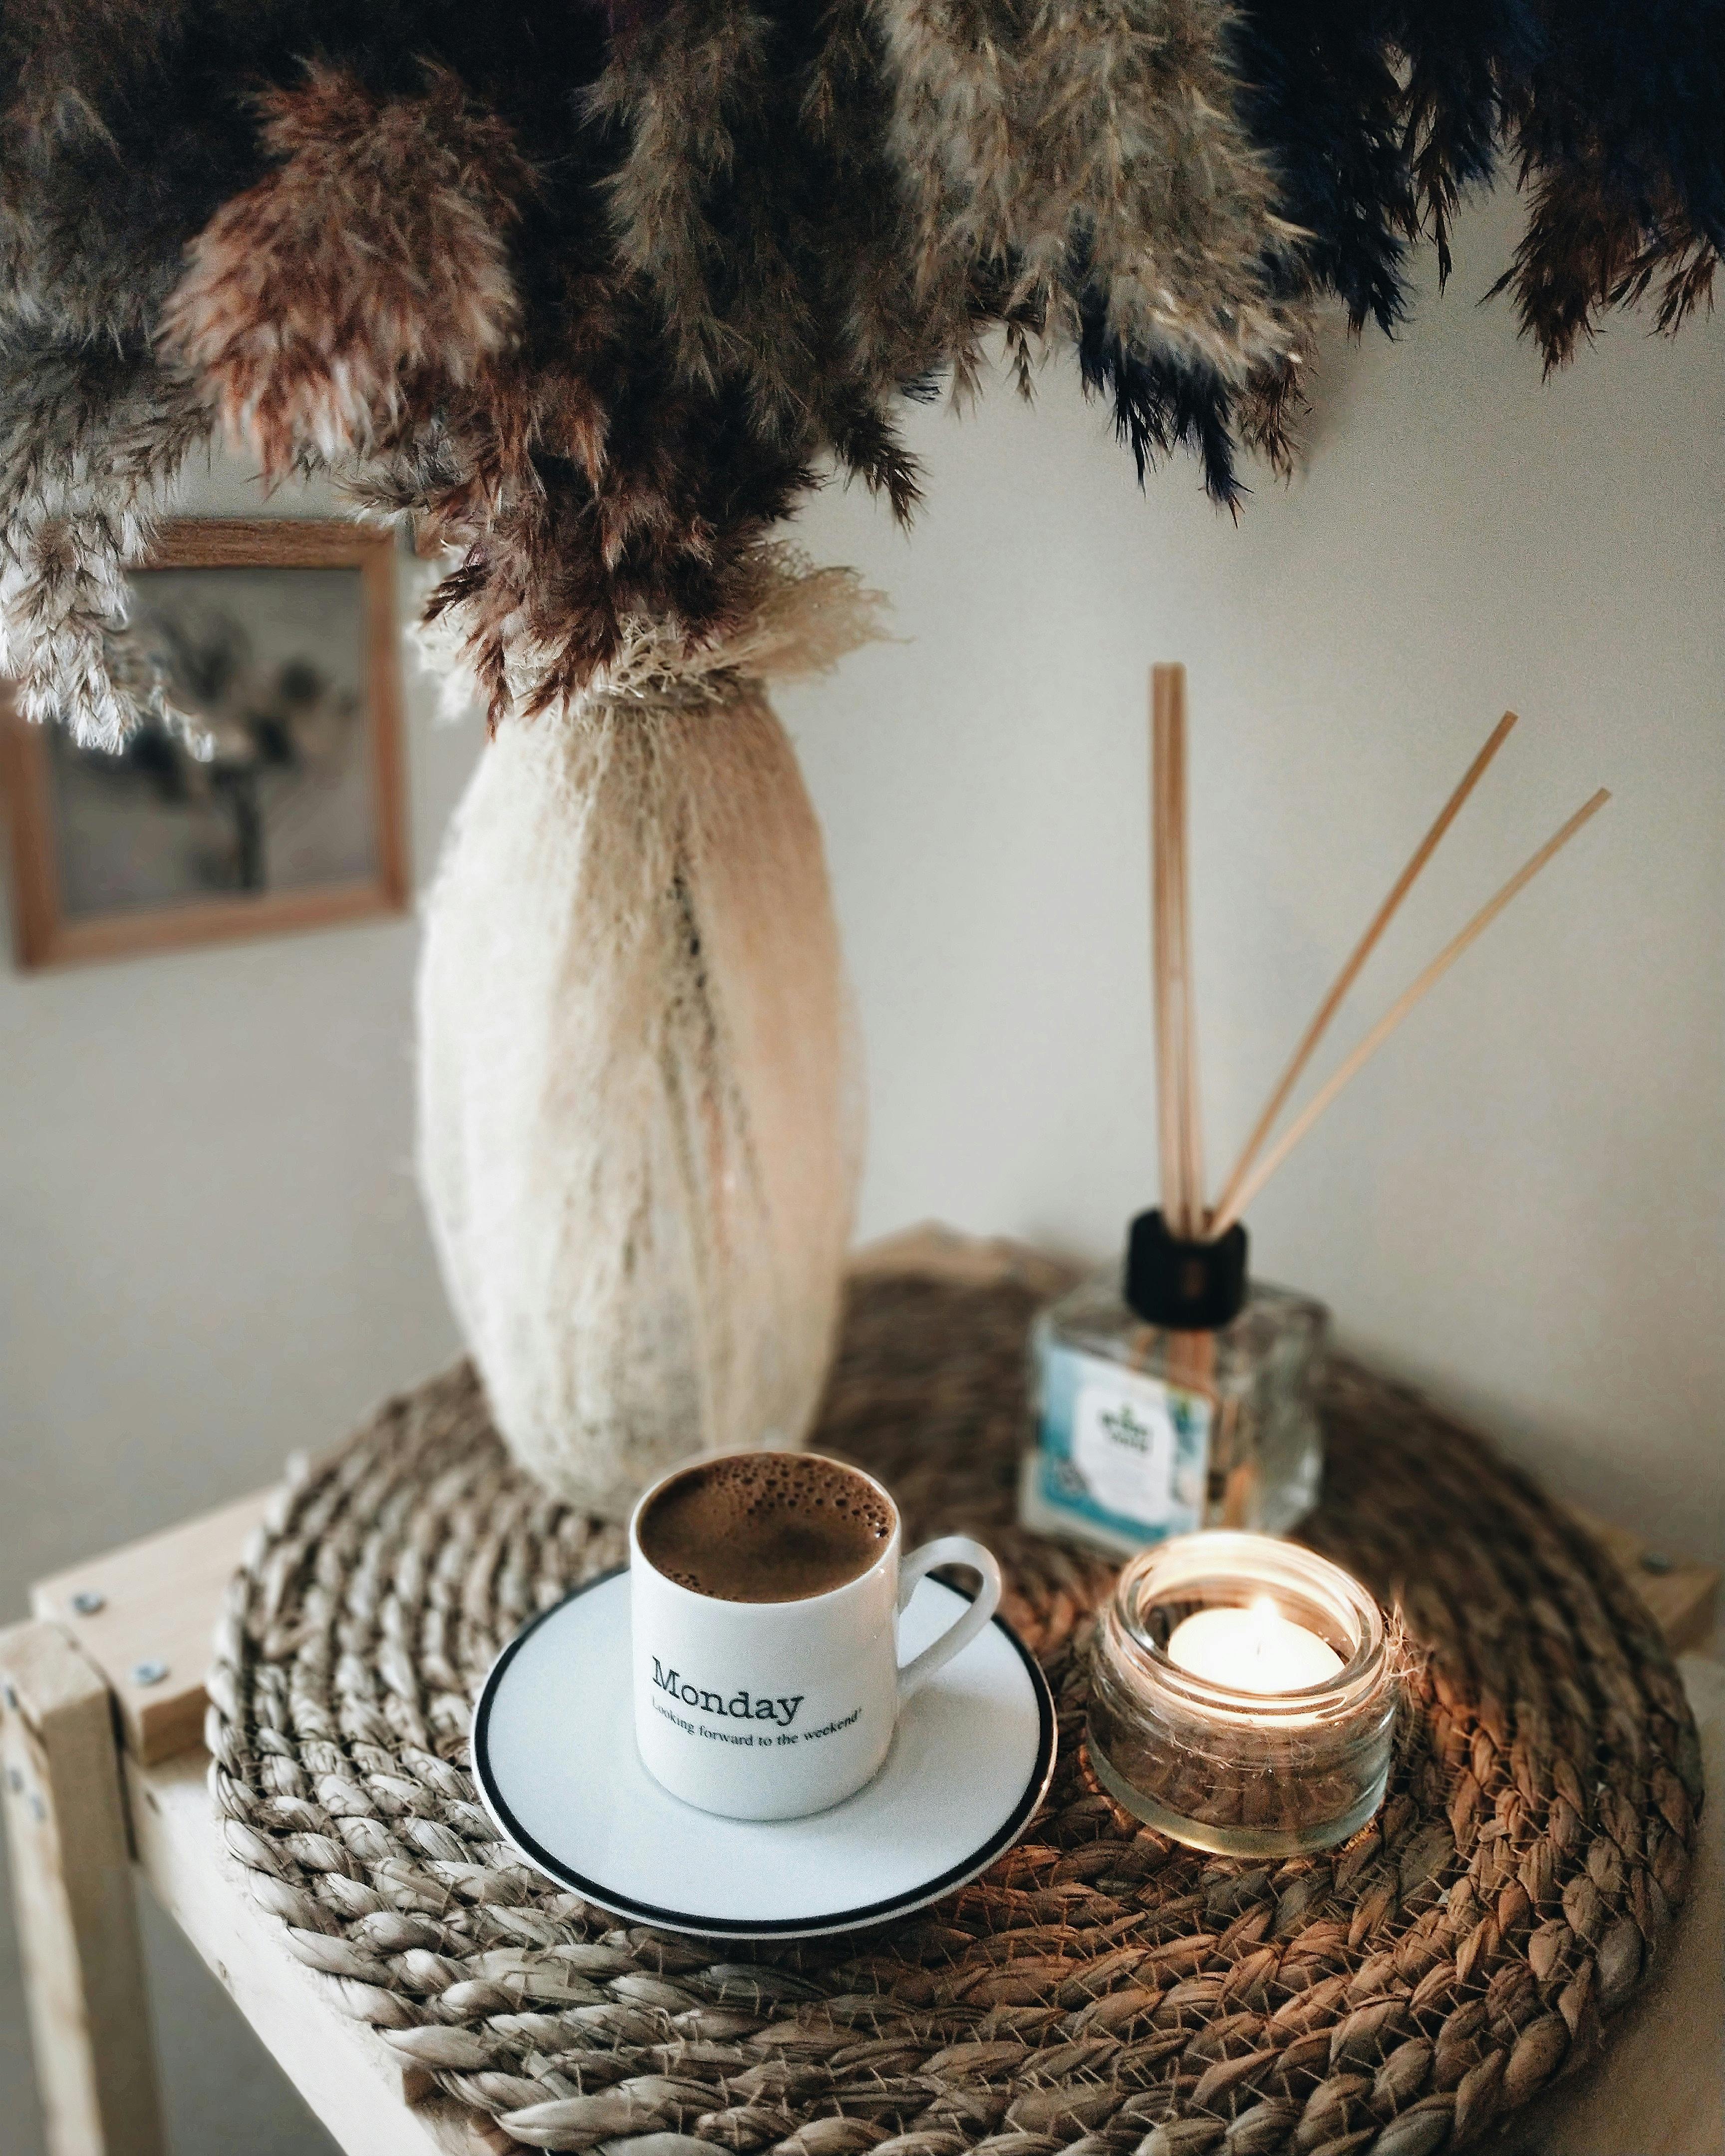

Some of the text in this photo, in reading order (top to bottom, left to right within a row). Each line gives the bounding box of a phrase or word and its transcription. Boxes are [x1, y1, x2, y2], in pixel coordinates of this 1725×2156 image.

[652, 1655, 805, 1726] Monday
[652, 1696, 695, 1736] Looking
[699, 1725, 753, 1746] forward
[758, 1736, 772, 1746] to
[776, 1734, 799, 1746] the
